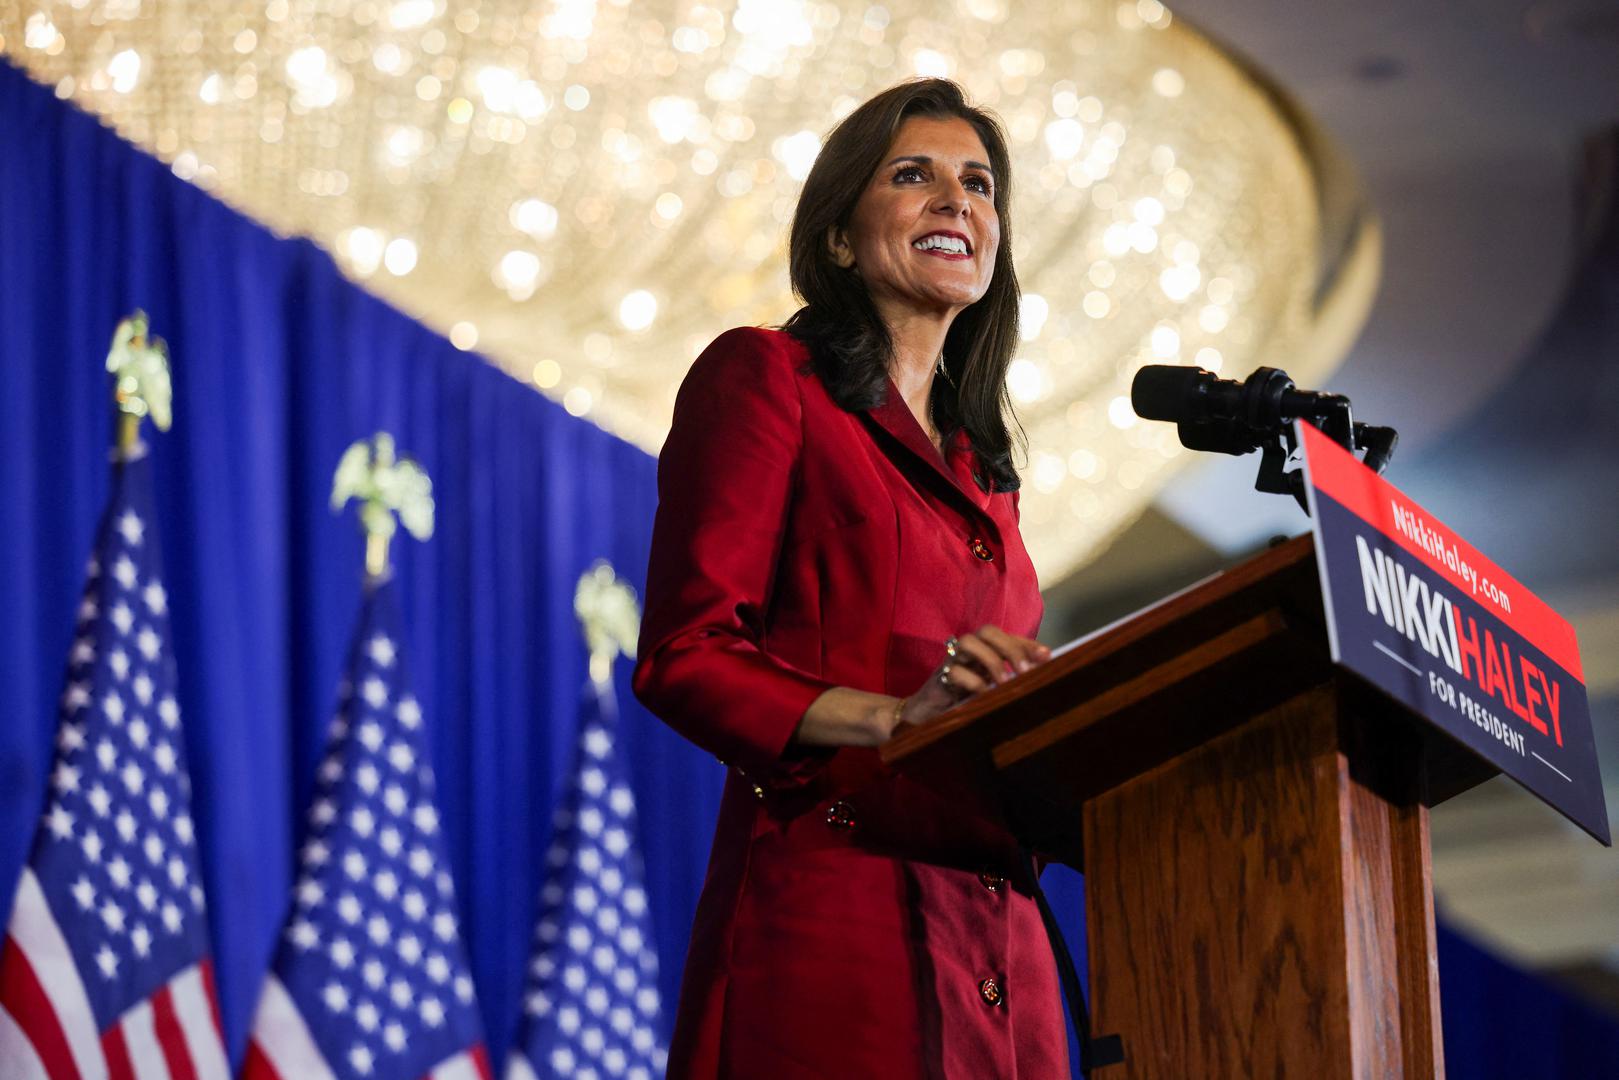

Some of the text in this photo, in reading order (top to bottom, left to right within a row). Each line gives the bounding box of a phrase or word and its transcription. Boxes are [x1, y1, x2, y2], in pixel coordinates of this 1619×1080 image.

[1391, 500, 1511, 614] NikkiHaley.com
[1428, 671, 1525, 757] FOR PRESIDENT
